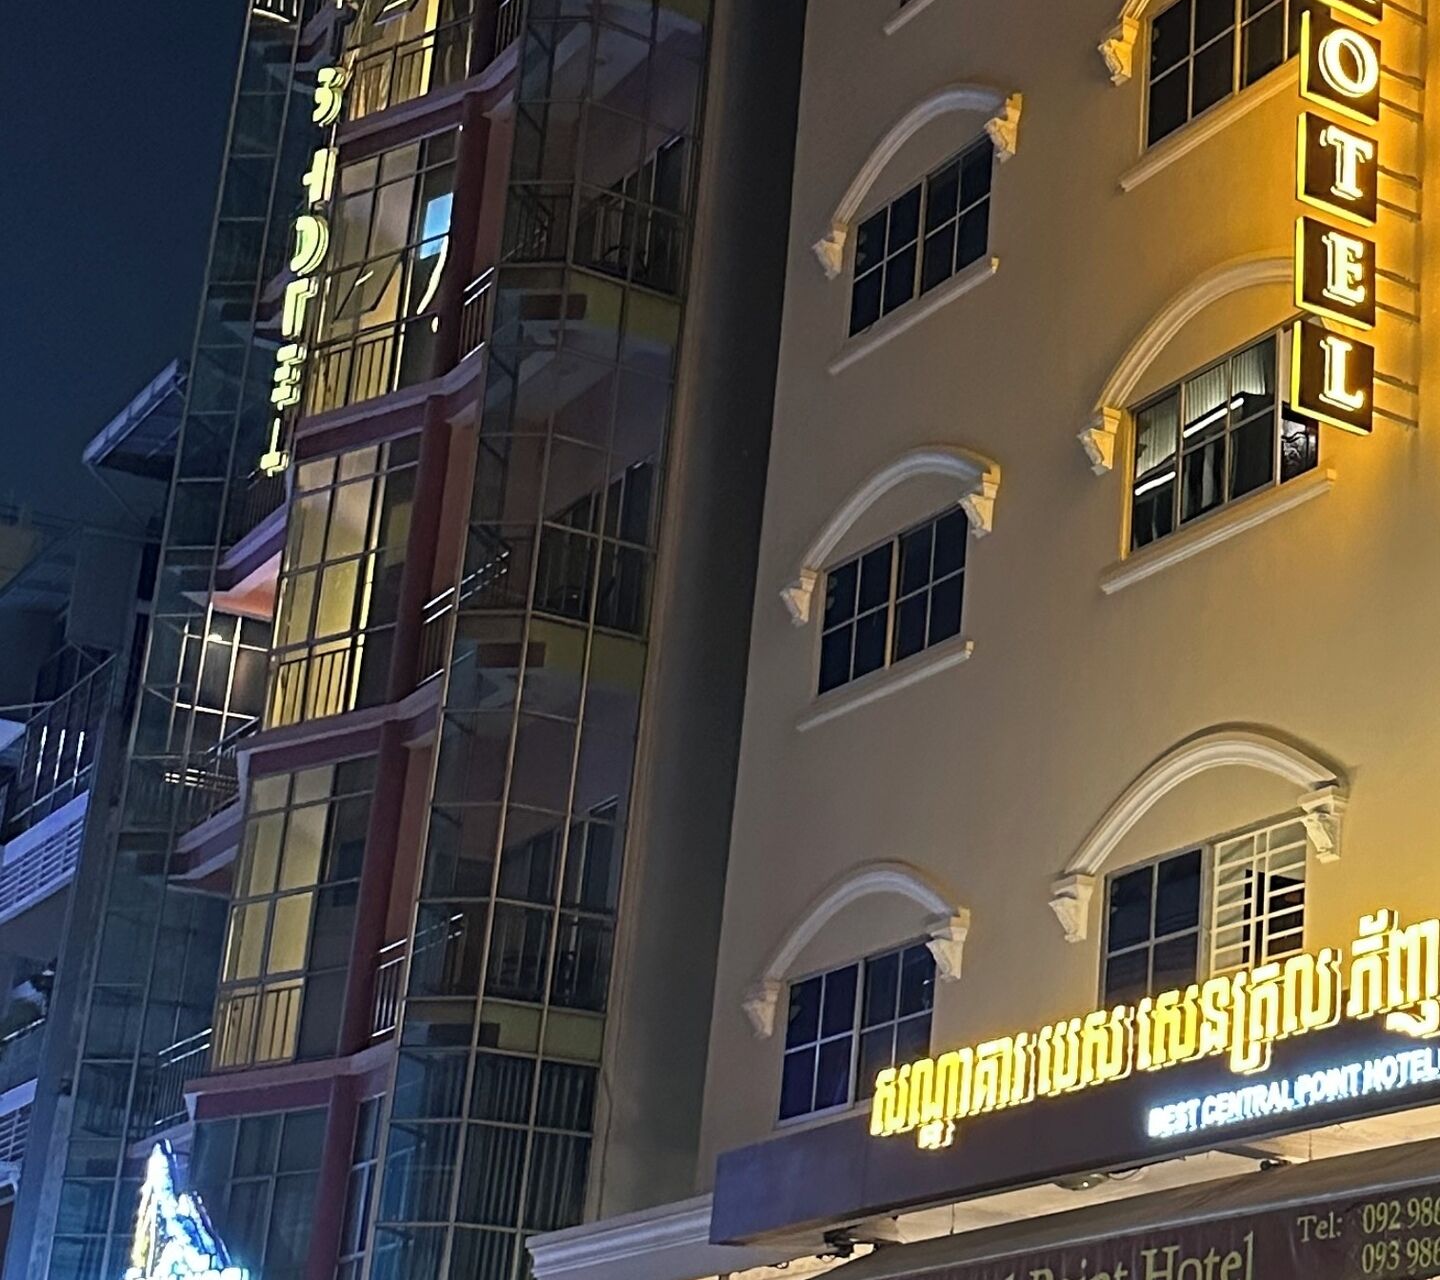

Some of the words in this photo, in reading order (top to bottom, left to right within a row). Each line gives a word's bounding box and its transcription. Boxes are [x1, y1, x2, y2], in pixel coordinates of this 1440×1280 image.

[1148, 1098, 1201, 1138] BEST
[1200, 1079, 1295, 1129] CENTRAL
[1295, 1062, 1362, 1107] POINT
[1297, 1211, 1343, 1243] Tel:
[1362, 1200, 1401, 1234] 092
[1361, 1239, 1401, 1274] 093
